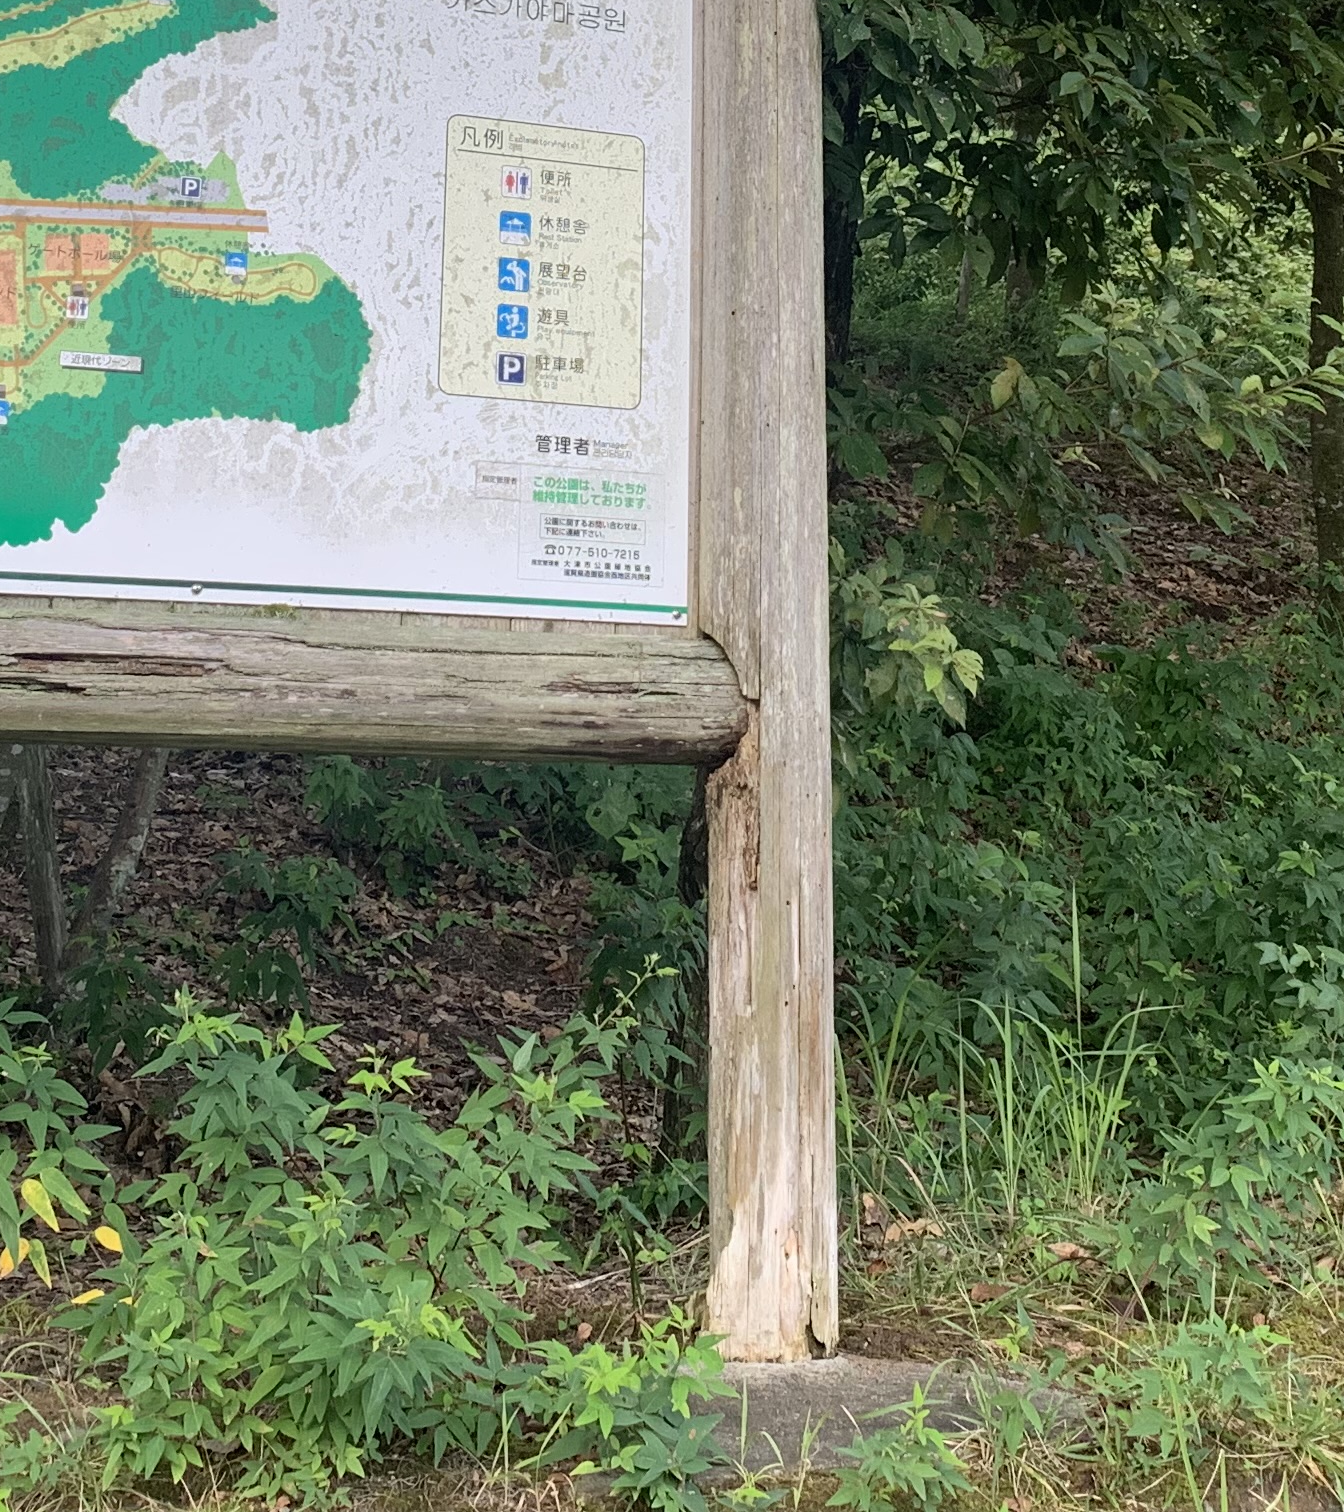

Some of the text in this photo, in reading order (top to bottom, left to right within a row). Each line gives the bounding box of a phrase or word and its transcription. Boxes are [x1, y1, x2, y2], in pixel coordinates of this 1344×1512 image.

[460, 125, 504, 150] 凡例
[540, 169, 572, 187] 便所
[539, 214, 590, 235] 休憩舎
[539, 261, 588, 282] 展望台
[537, 307, 570, 327] 遊具
[535, 354, 585, 374] 駐車場
[535, 434, 591, 456] 管理者
[593, 439, 629, 450] Manager
[533, 475, 647, 495] この公園は、私たちが
